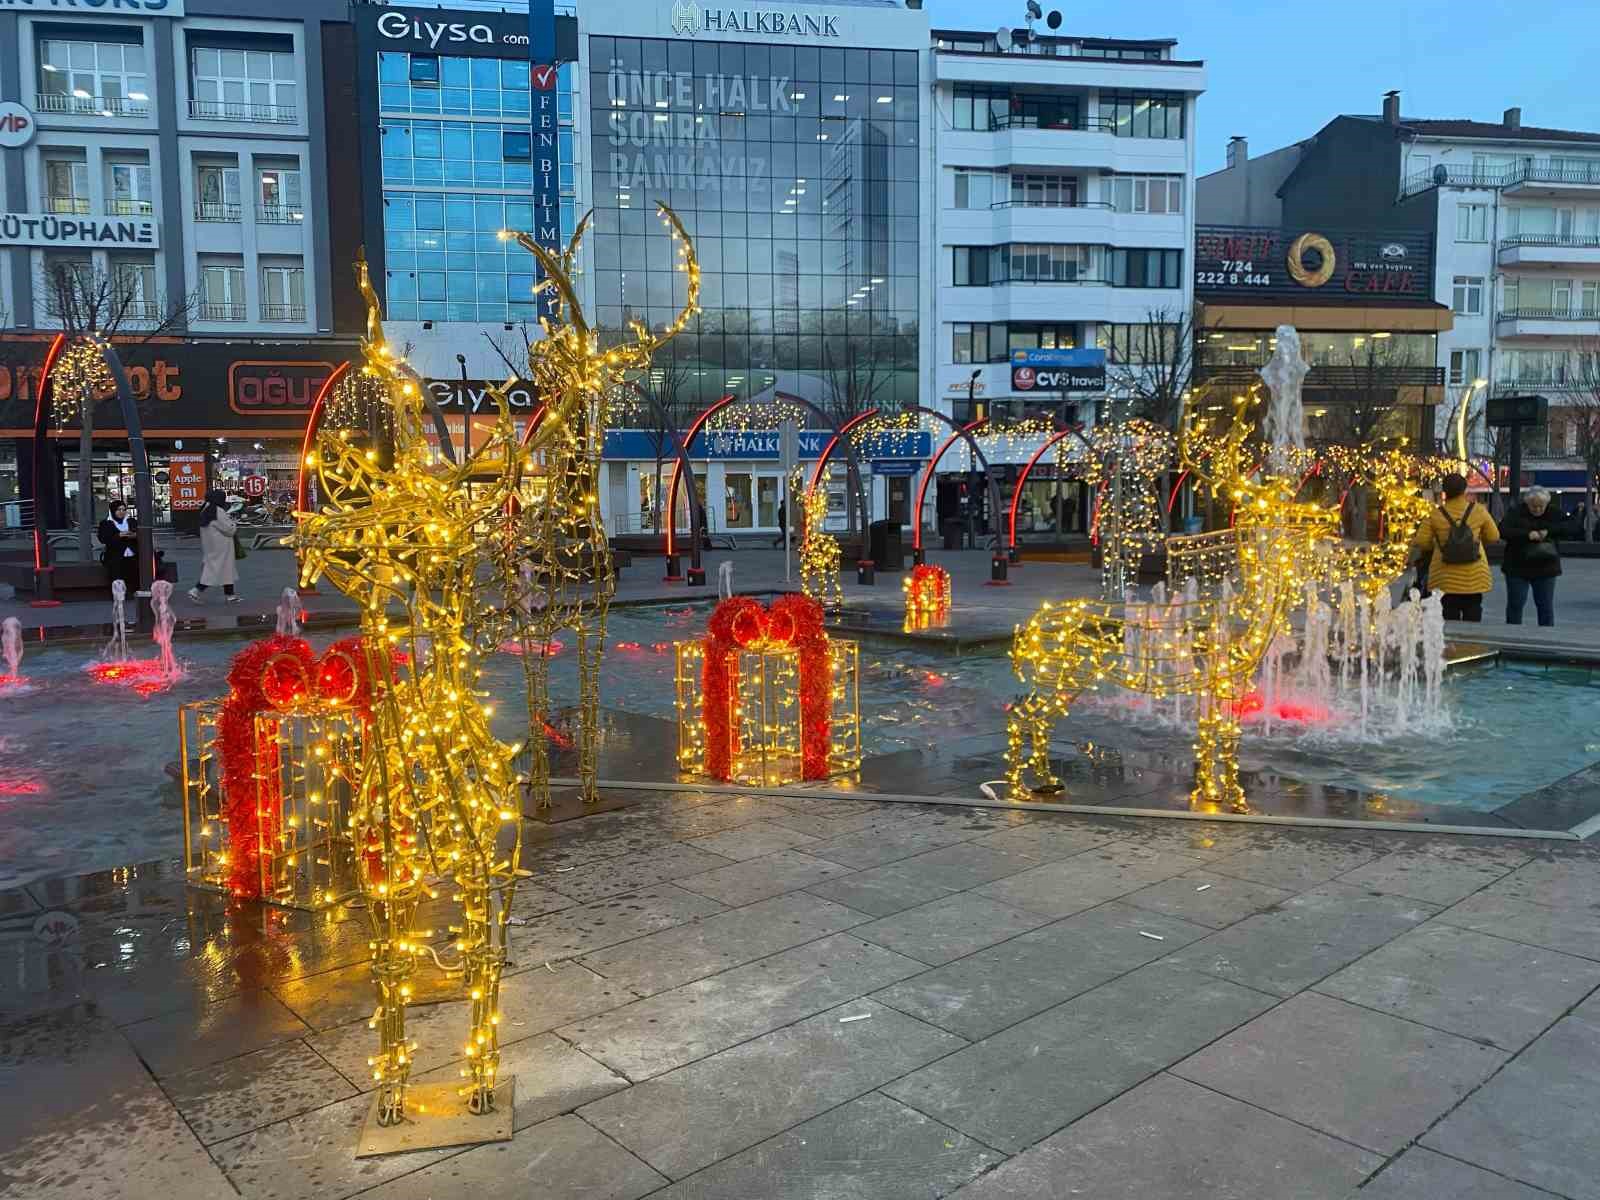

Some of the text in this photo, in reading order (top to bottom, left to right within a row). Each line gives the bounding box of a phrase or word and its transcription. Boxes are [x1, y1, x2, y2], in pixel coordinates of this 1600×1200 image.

[377, 12, 494, 49] Giysa
[704, 9, 840, 37] HALKBANK
[608, 59, 790, 111] ÖNCE HALK
[608, 110, 720, 149] SONRA
[540, 95, 556, 315] FEN BİLİMRİ
[0, 215, 152, 242] ÜTÜPHANE
[1197, 272, 1270, 286] 222 8 444
[1221, 260, 1253, 272] 7/24
[1036, 371, 1069, 386] CVS
[427, 381, 532, 413] Giya
[734, 437, 820, 452] HALKNK
[174, 473, 201, 484] Apple
[248, 479, 262, 494] 15
